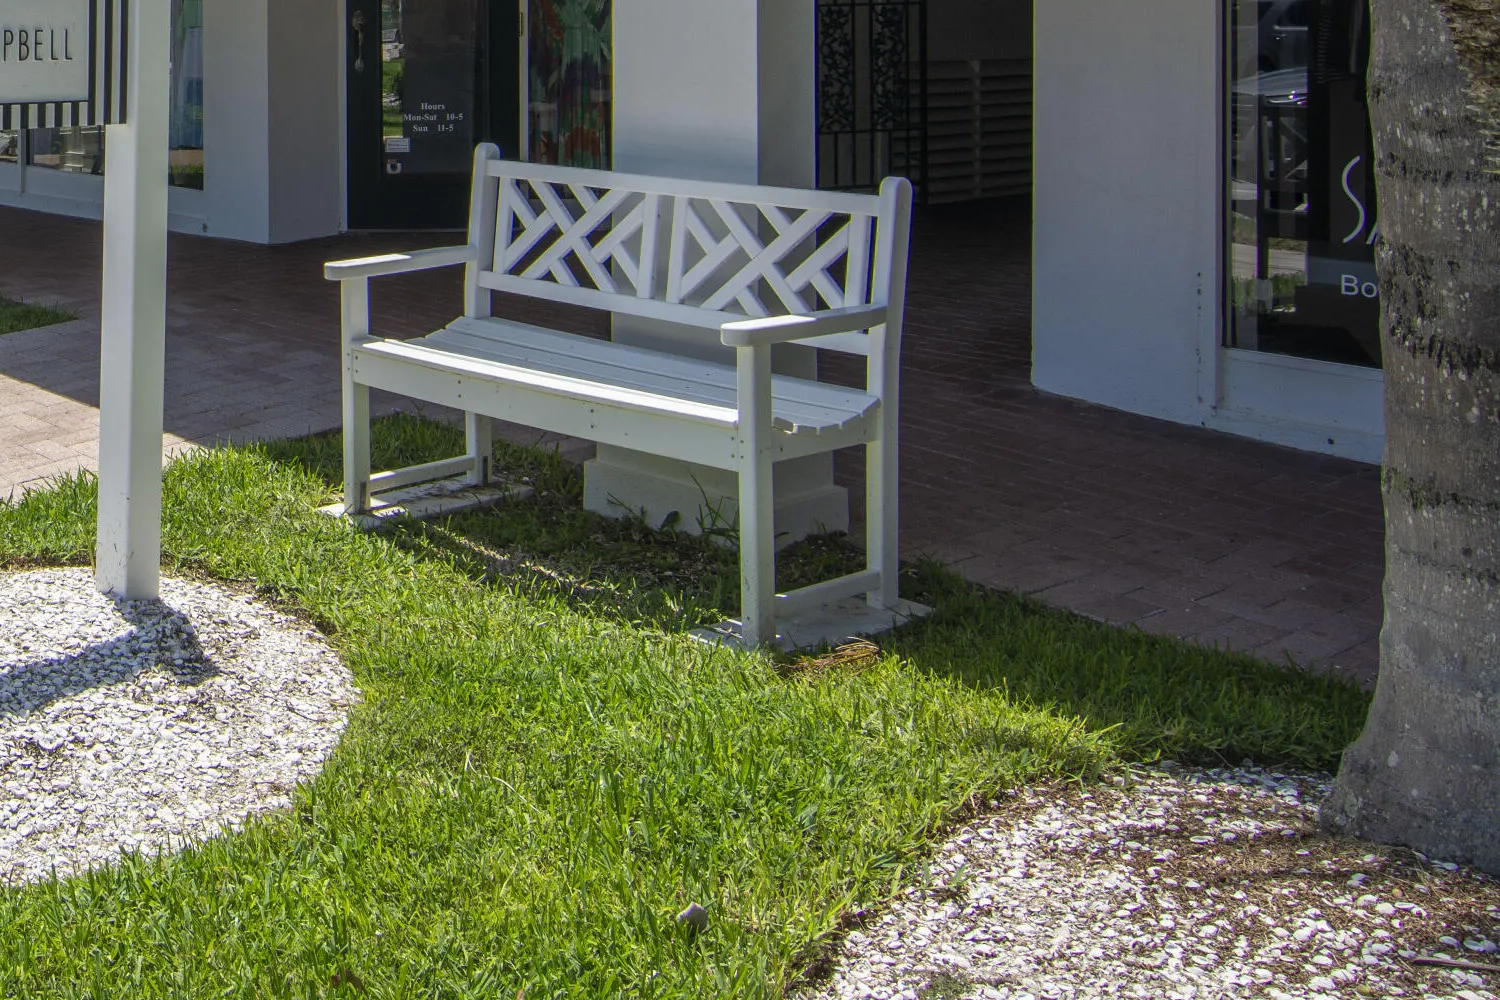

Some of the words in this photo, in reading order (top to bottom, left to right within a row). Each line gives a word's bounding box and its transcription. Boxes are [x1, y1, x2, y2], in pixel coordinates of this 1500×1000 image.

[420, 102, 446, 110] Hours
[403, 113, 437, 121] Mon-Sat
[446, 113, 464, 121] 10-5
[412, 124, 429, 132] Sun
[437, 124, 454, 132] 11-5
[1341, 154, 1378, 245] S
